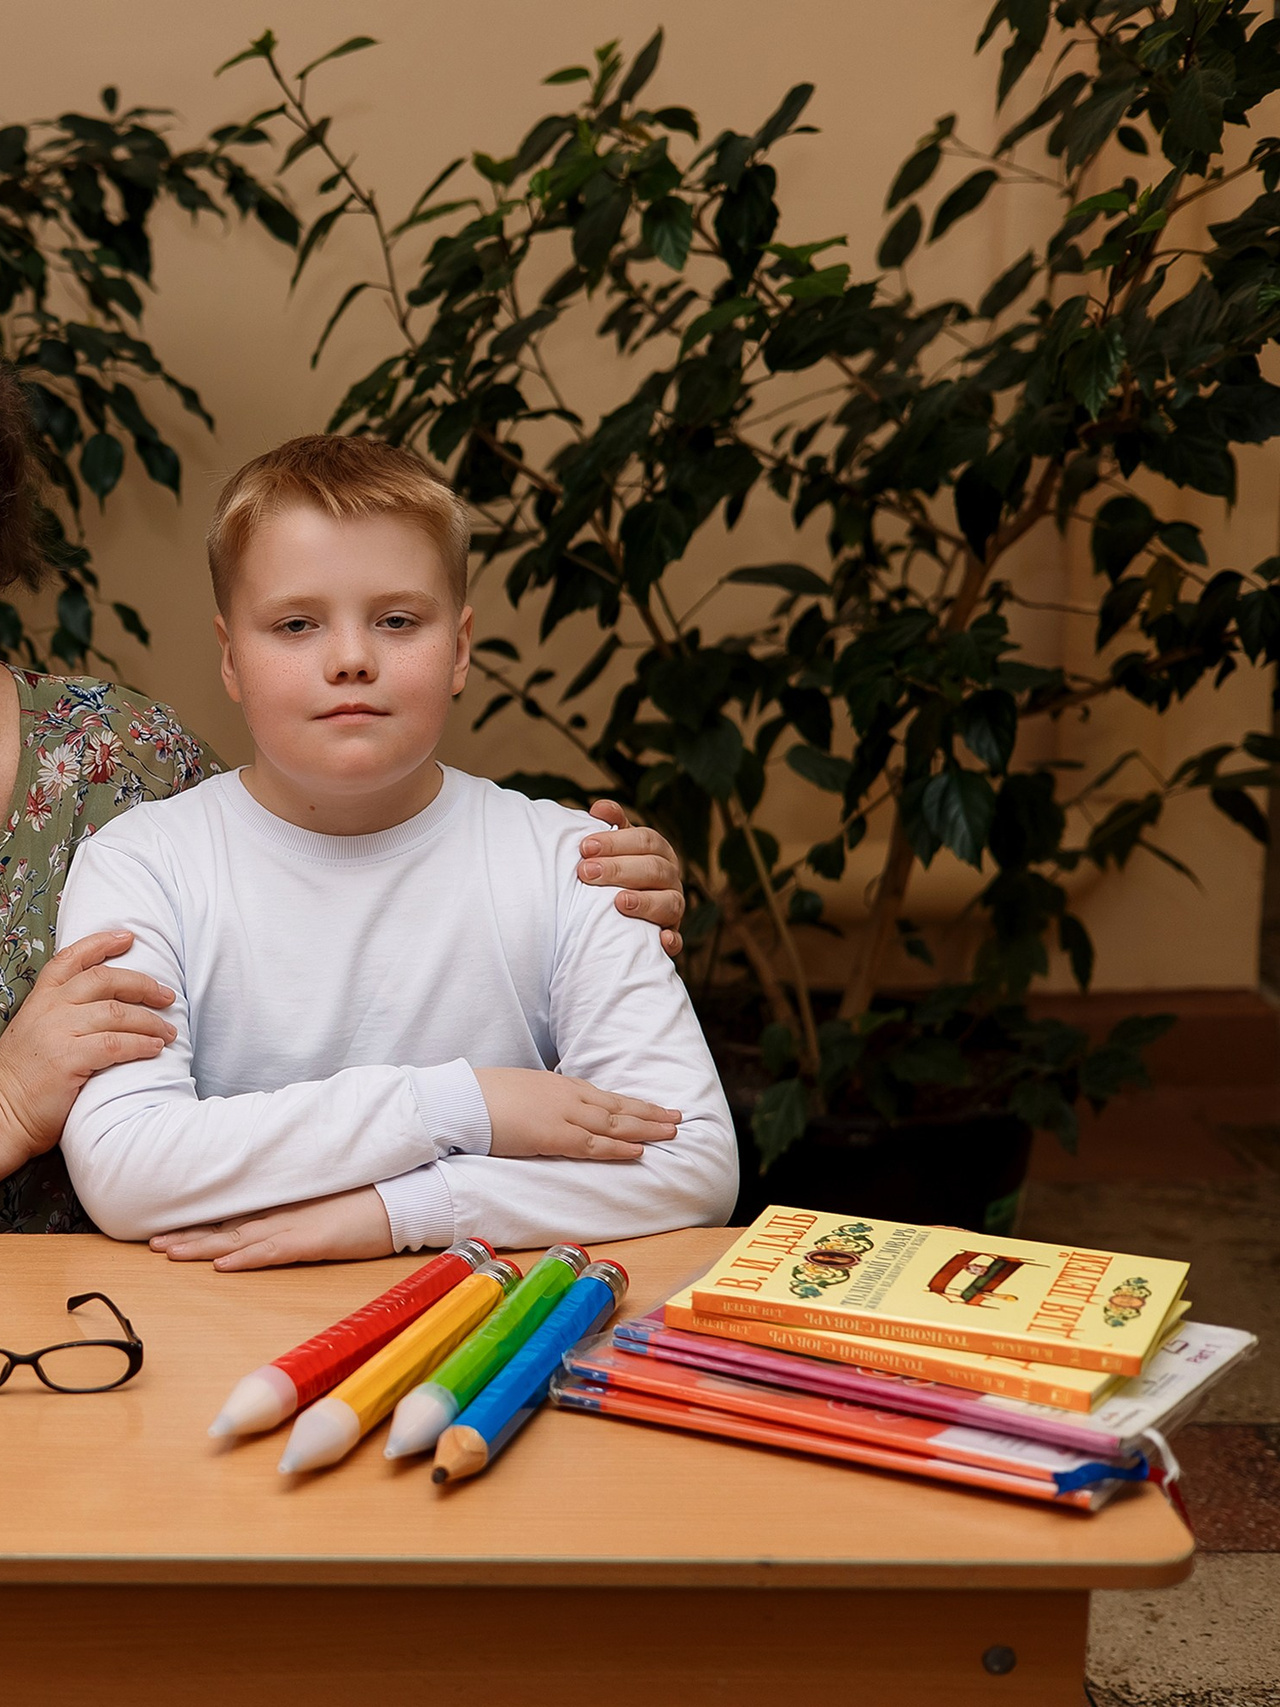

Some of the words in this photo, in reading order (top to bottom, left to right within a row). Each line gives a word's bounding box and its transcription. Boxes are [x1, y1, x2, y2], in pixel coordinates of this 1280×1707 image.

[747, 1213, 819, 1257] ДАЛЬ
[730, 1256, 784, 1273] И.
[840, 1260, 892, 1307] ТОЛКОВЫЙ
[874, 1228, 917, 1261] СЛОВАРЬ
[715, 1276, 768, 1292] В.
[1047, 1251, 1114, 1306] ДЕТЕЙ
[722, 1301, 756, 1315] ДЕТЕЙ
[762, 1306, 785, 1318] ДЛЯ
[692, 1316, 726, 1330] ДЕТЕЙ
[804, 1312, 875, 1333] СЛОВАРЬ
[1026, 1300, 1086, 1341] ДЛЯ
[768, 1331, 836, 1352] СЛОВАРЬ
[879, 1322, 968, 1347] ТОЛКОВЫЙ
[839, 1347, 924, 1373] ТОЛКОВЫЙ
